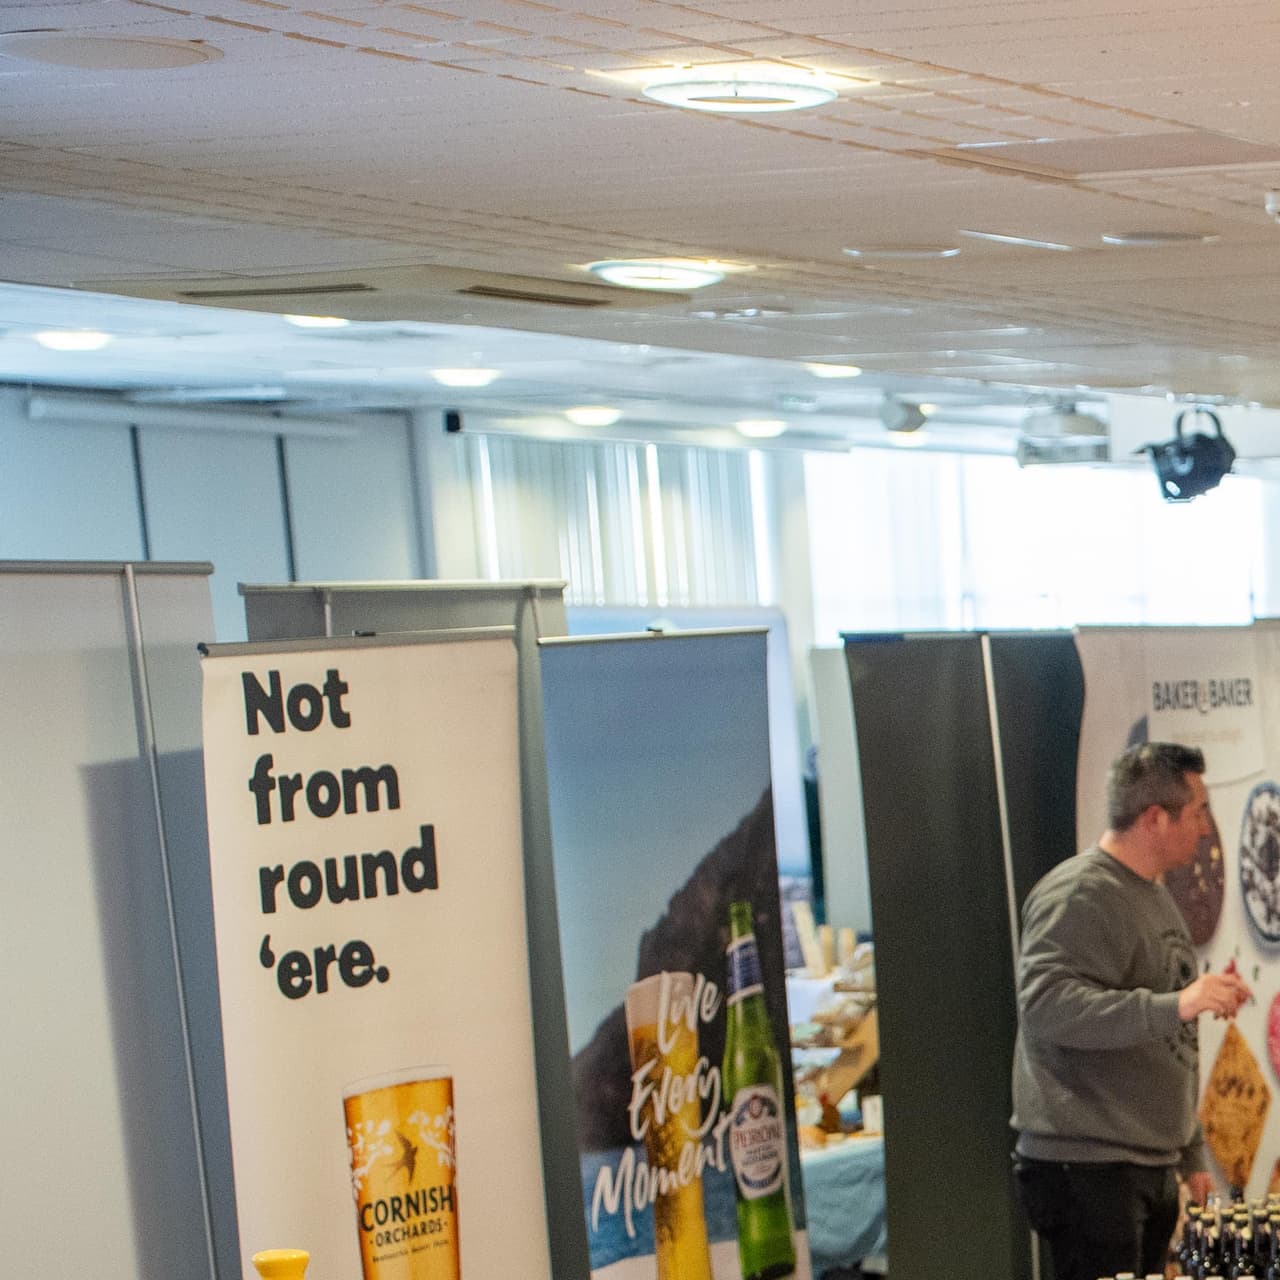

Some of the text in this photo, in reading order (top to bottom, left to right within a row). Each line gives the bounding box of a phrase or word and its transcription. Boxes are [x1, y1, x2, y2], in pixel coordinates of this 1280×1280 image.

[242, 669, 351, 735] Not
[1153, 680, 1198, 711] BAKER
[1208, 678, 1253, 708] BAKER
[249, 754, 400, 824] from
[259, 824, 438, 914] round
[657, 971, 721, 1055] Live
[628, 1057, 721, 1141] Every
[361, 1184, 454, 1232] CORNISH
[591, 1108, 740, 1239] Moment
[375, 1218, 444, 1247] ORCHARDS
